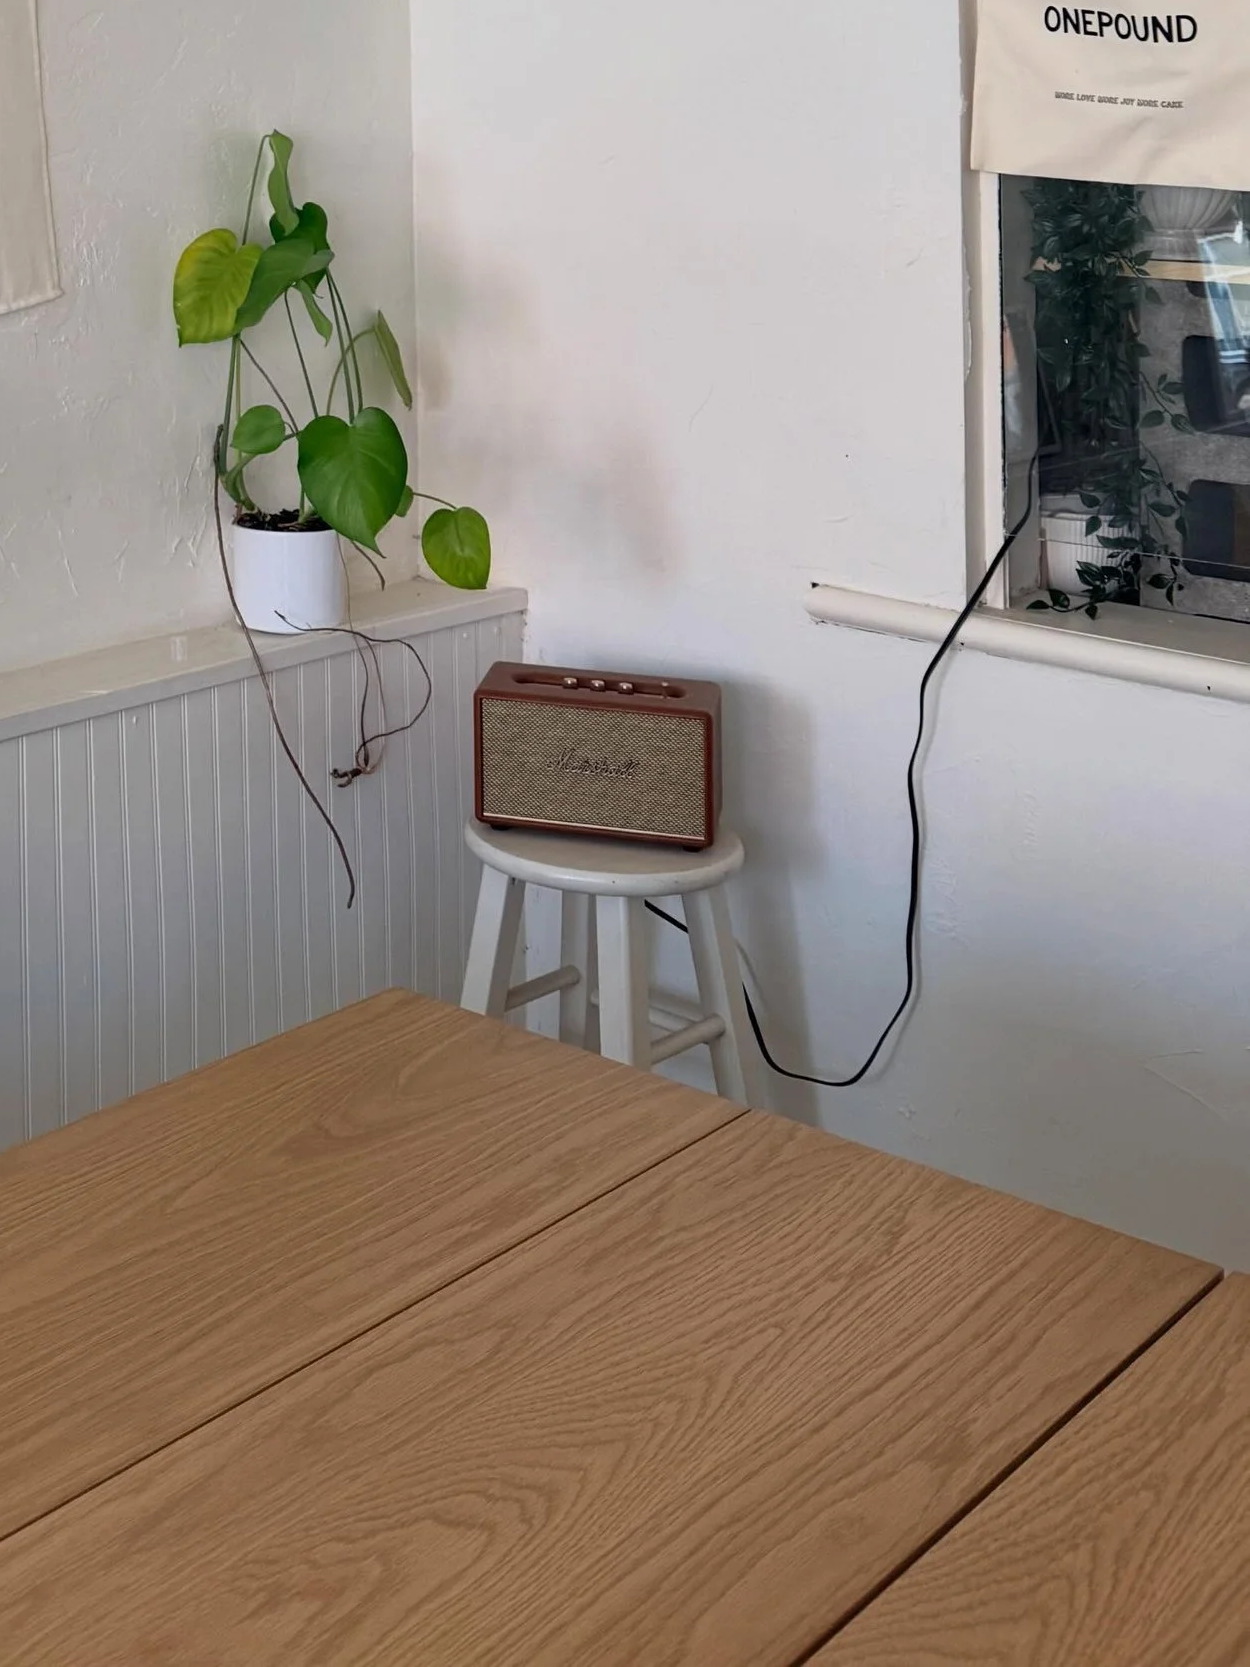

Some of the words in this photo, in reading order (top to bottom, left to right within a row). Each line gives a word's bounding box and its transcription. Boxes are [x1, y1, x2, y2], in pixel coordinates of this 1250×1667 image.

[1044, 5, 1198, 43] ONEPOUND
[1076, 94, 1096, 103] LOVE
[1120, 98, 1136, 106] JOY
